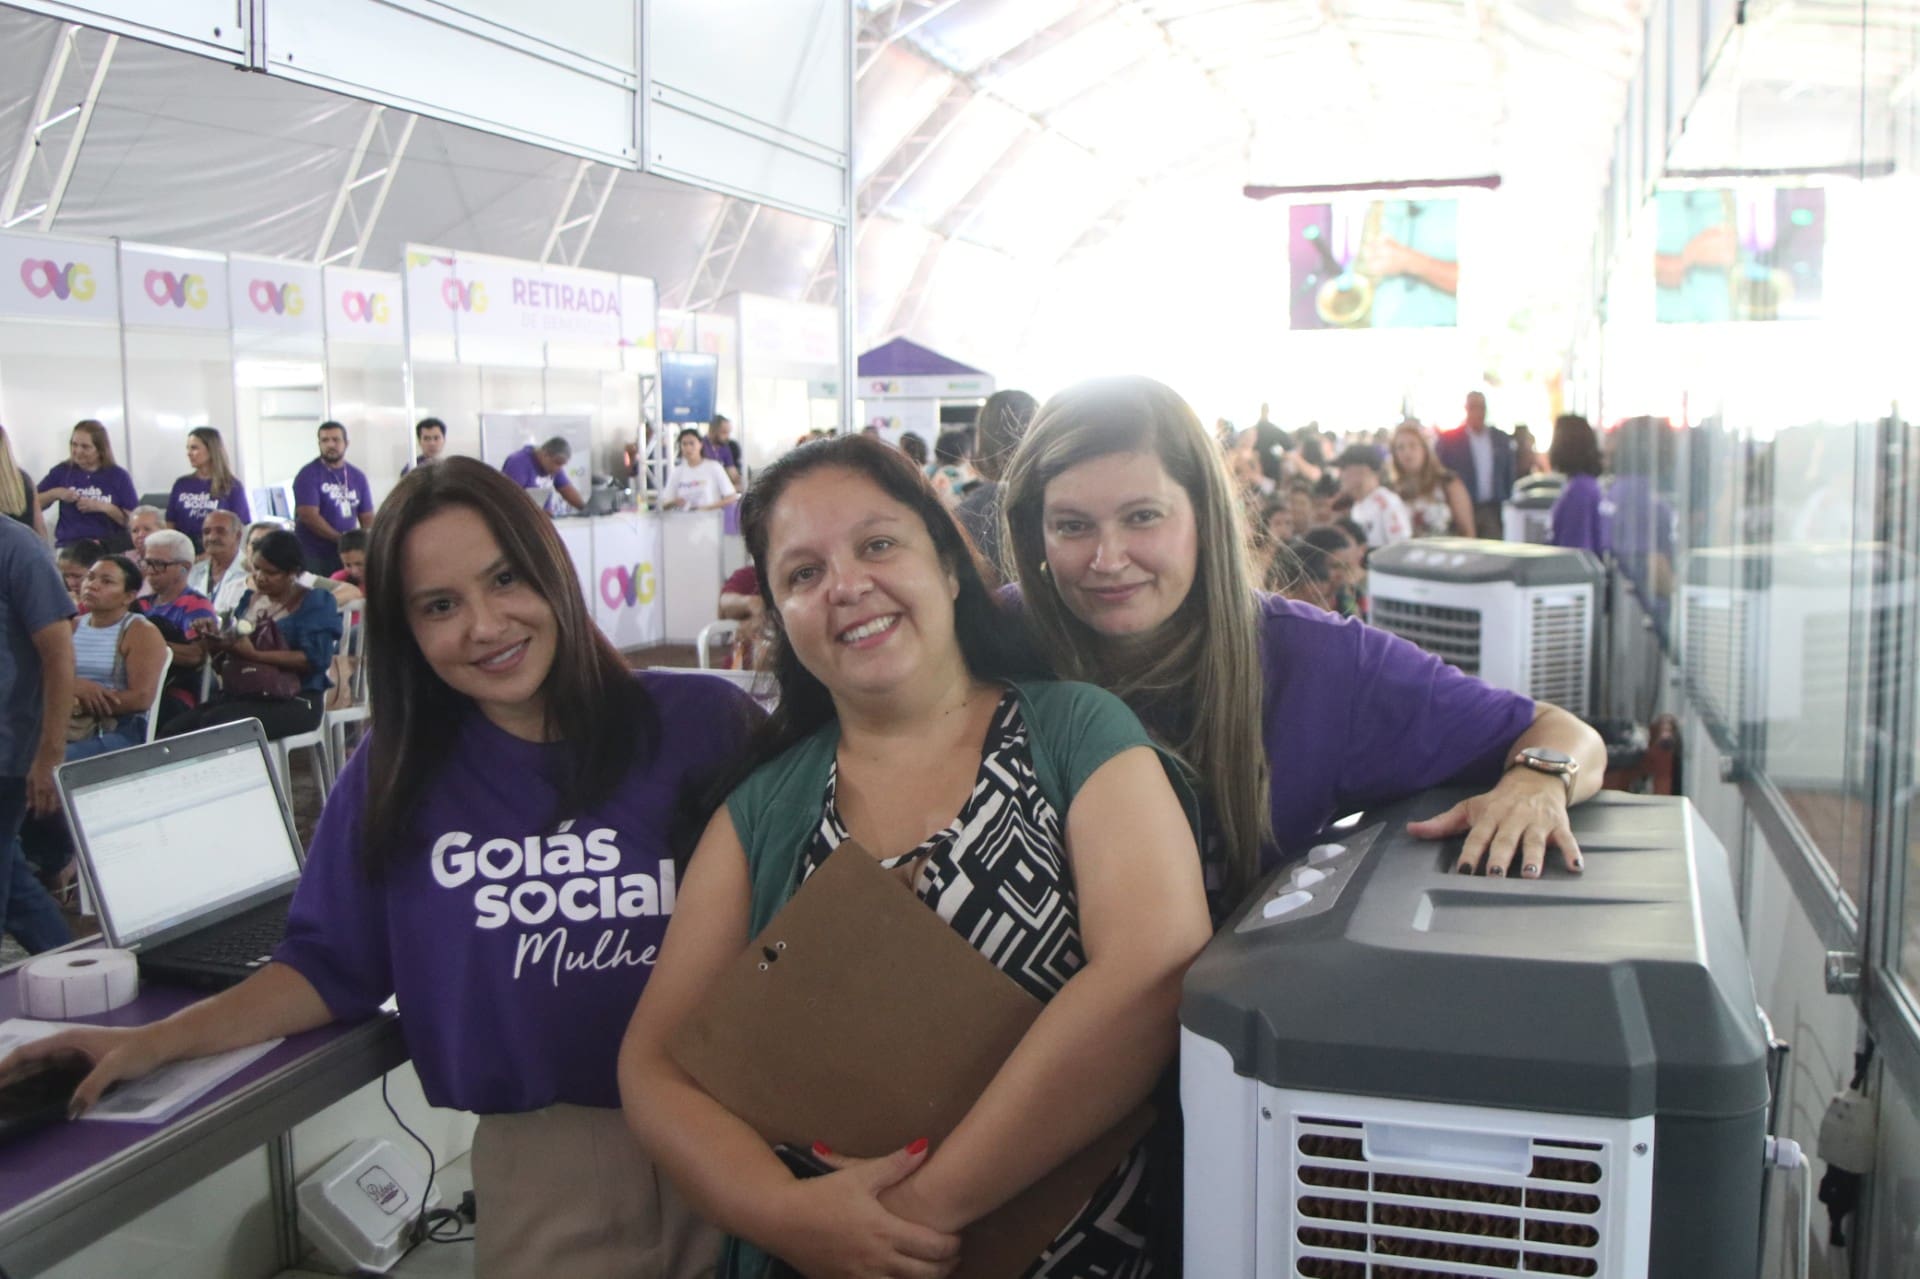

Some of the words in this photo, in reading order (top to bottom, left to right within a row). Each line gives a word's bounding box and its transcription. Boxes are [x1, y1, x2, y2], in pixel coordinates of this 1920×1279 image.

[20, 257, 97, 302] OVG
[143, 268, 209, 311] OVG
[248, 278, 305, 317] OVG
[440, 277, 490, 315] OVG
[512, 276, 622, 317] RETIRADA
[341, 289, 391, 326] OVG
[600, 560, 656, 611] OVG
[513, 927, 657, 988] Mulhe
